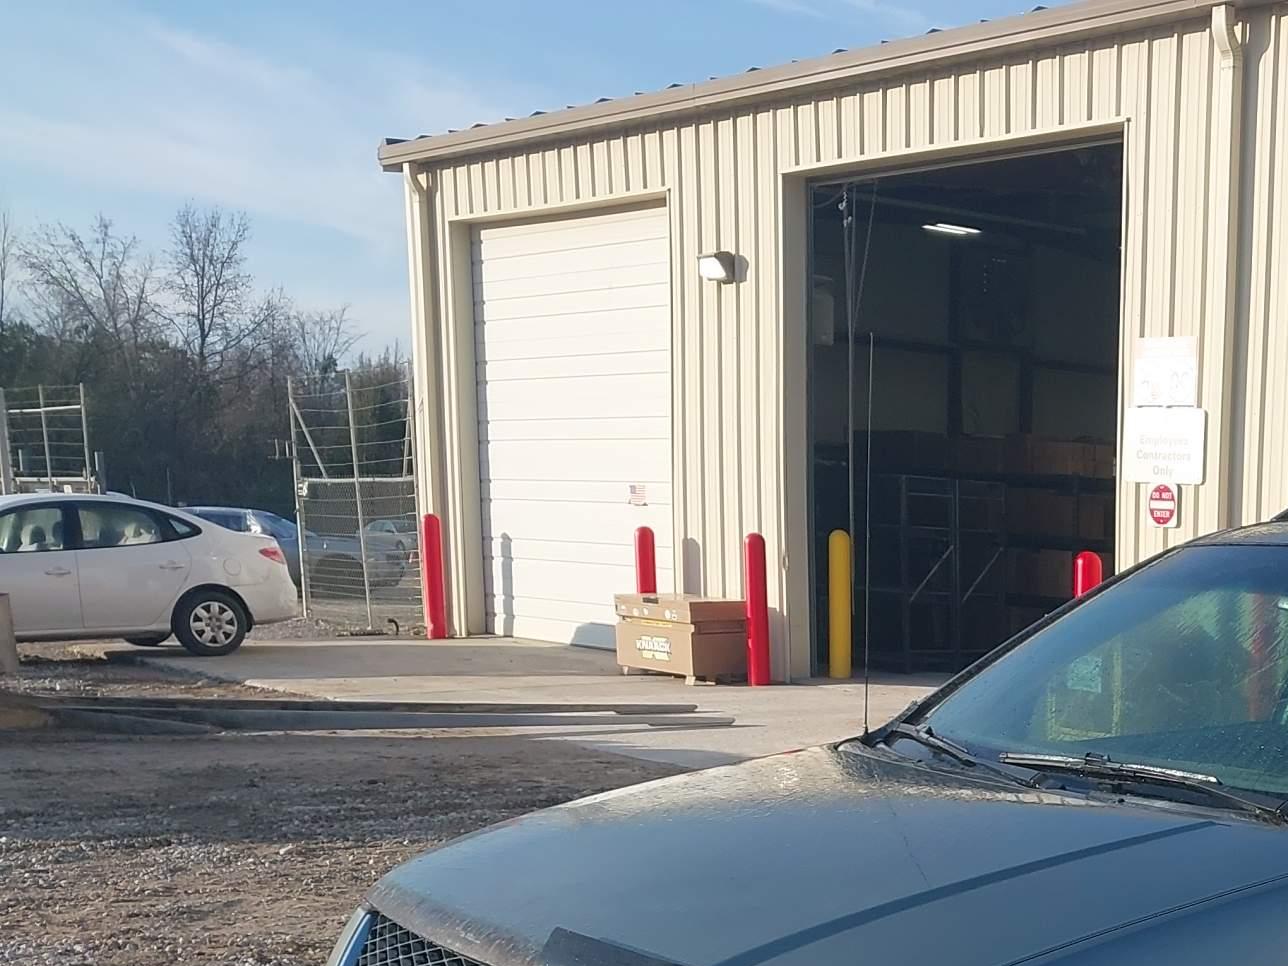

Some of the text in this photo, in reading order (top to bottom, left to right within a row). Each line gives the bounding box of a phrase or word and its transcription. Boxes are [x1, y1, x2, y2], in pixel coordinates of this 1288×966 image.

[1136, 449, 1192, 462] Contractors
[1152, 464, 1175, 478] Only
[1152, 491, 1172, 499] DO NOT
[1153, 510, 1170, 518] ENTER
